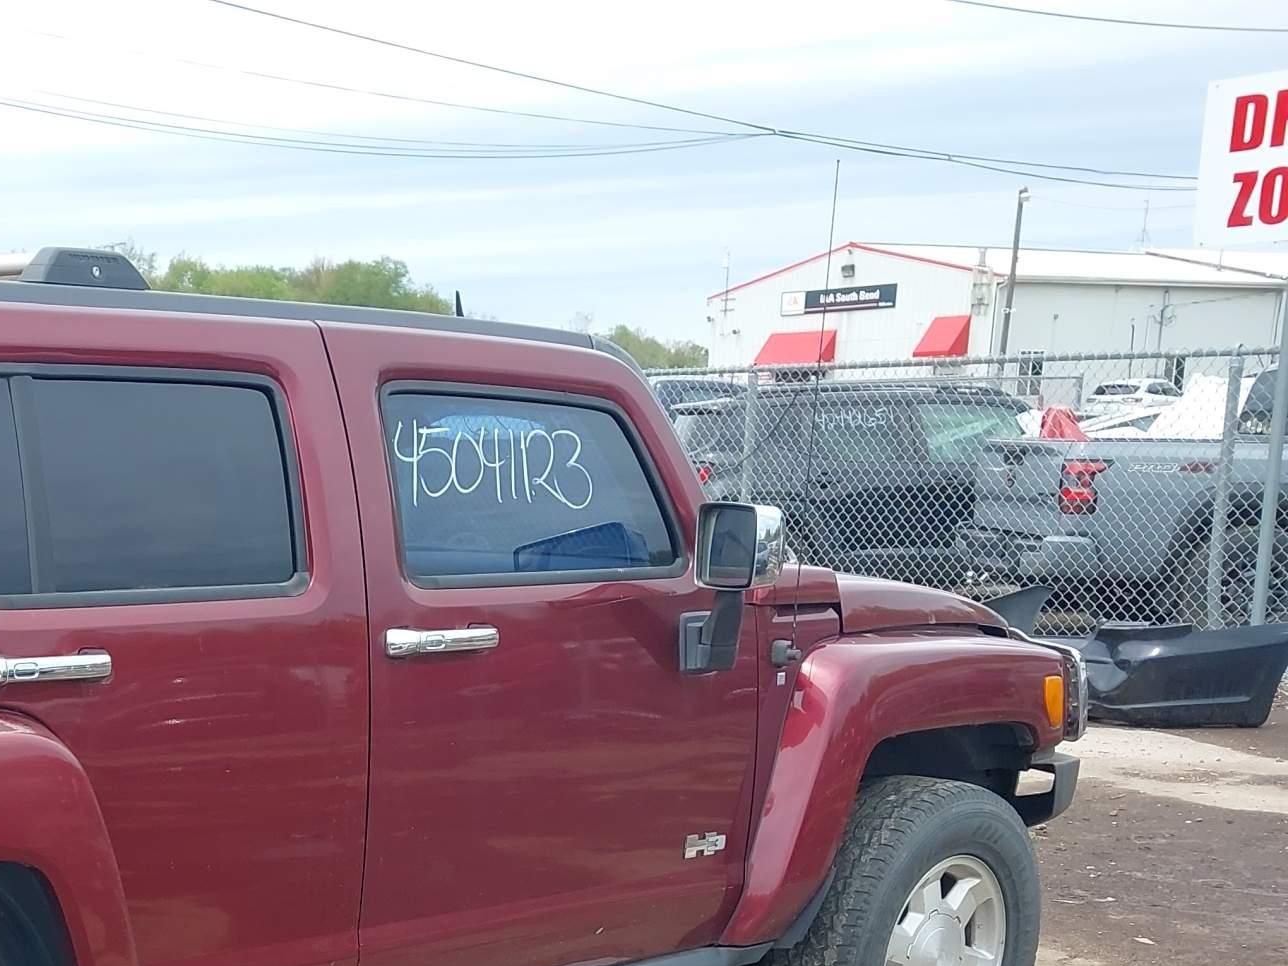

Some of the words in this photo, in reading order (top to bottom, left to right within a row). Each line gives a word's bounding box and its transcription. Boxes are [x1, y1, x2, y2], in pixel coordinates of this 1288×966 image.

[1226, 166, 1288, 228] ZO
[835, 290, 858, 303] South
[859, 288, 880, 301] Bend
[392, 417, 594, 510] 45041123
[684, 831, 727, 859] H3
